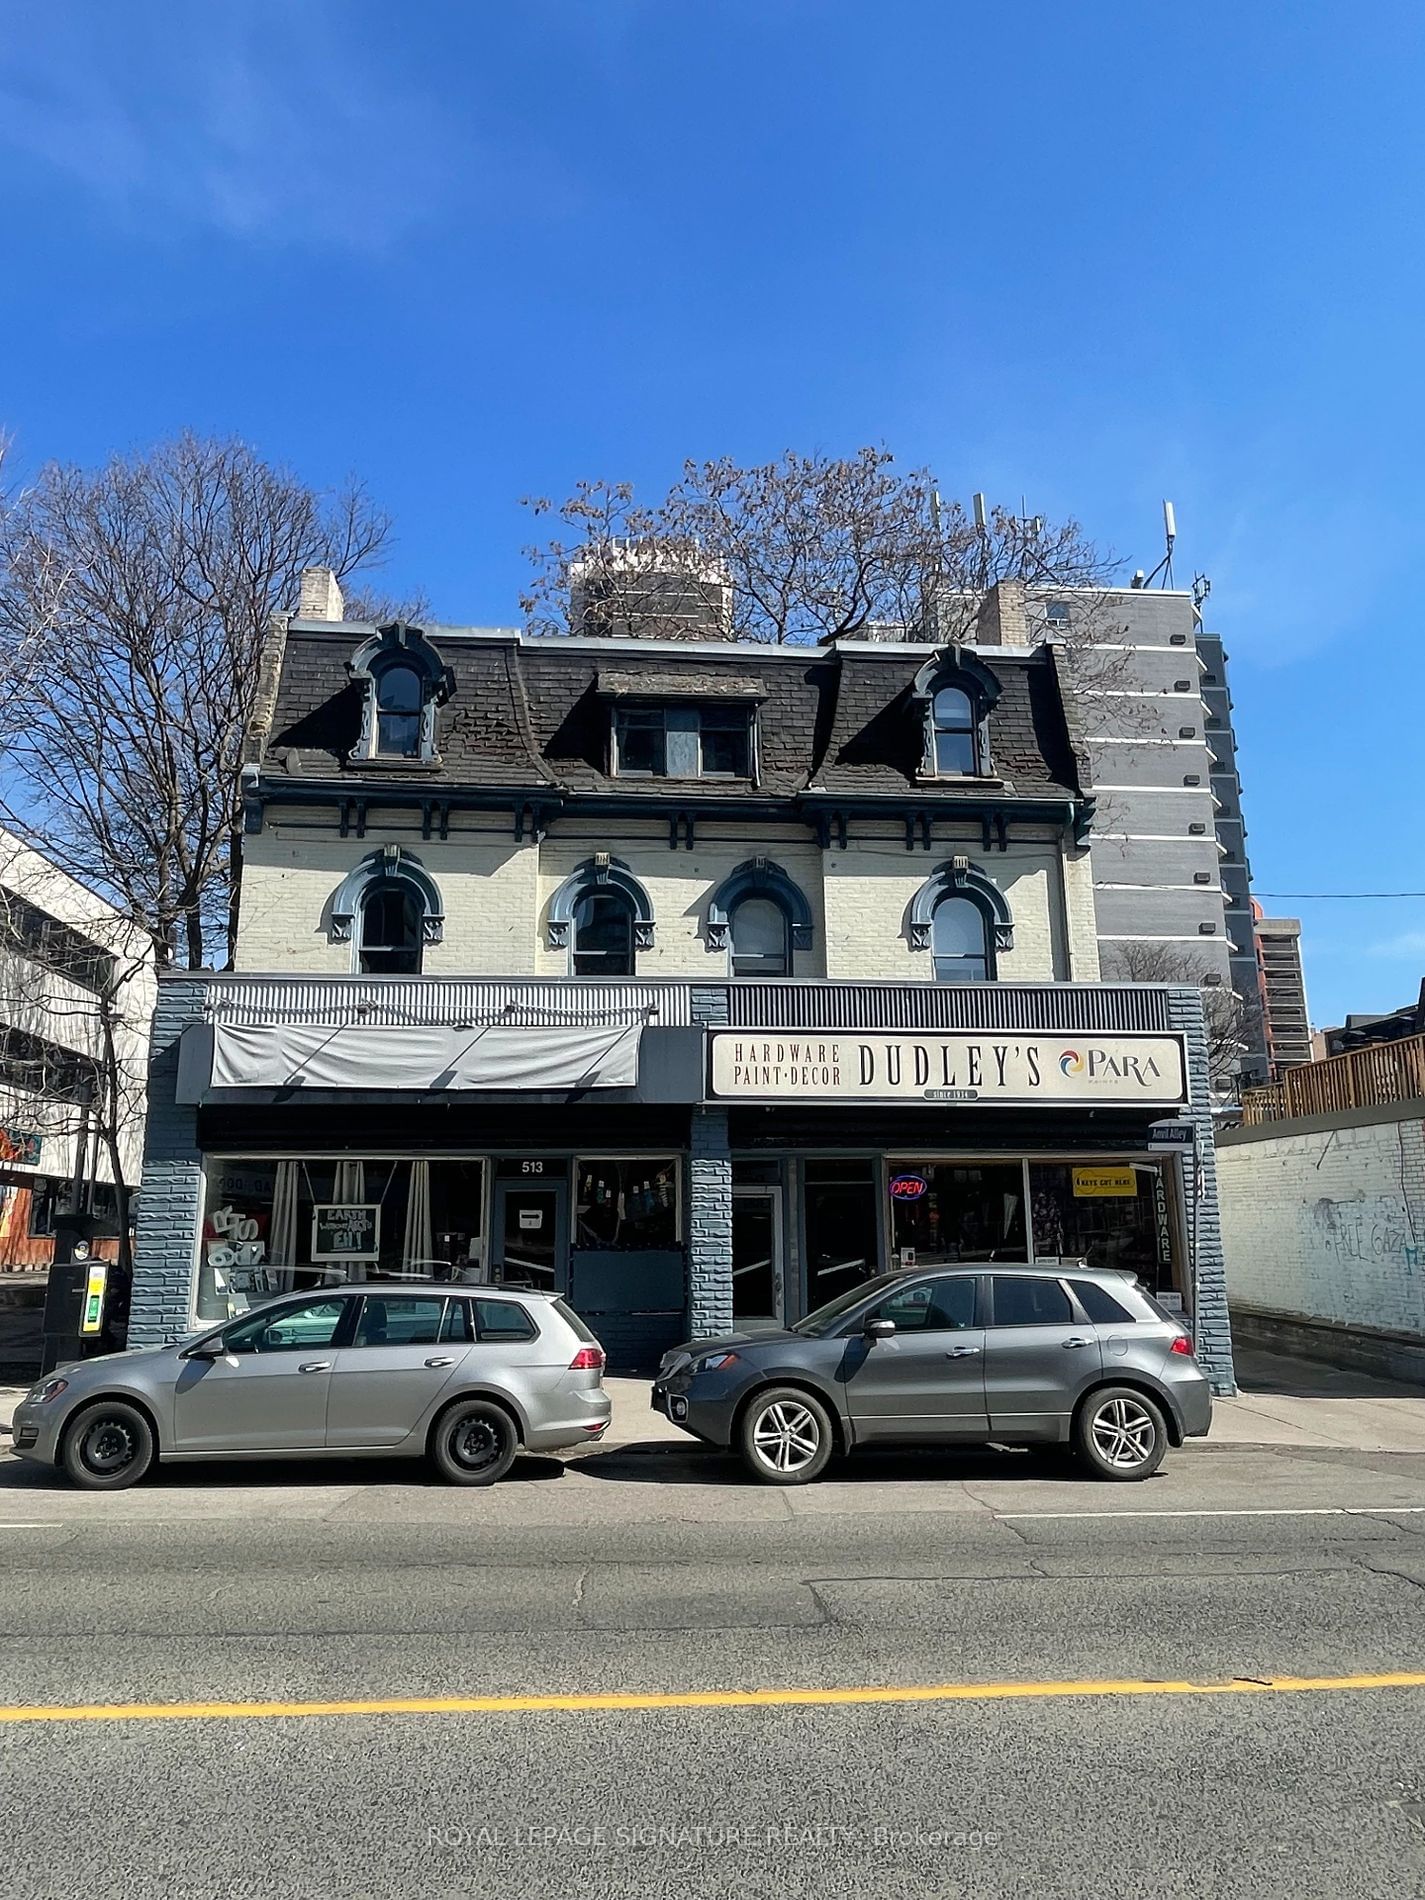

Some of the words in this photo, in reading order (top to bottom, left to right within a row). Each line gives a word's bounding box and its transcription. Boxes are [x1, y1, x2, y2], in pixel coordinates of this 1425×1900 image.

[735, 1043, 840, 1063] HARDWARE
[858, 1044, 1041, 1087] DUDLEY'S
[1088, 1049, 1161, 1087] PARA
[1170, 1128, 1187, 1141] Alley
[521, 1161, 543, 1173] 513
[891, 1181, 923, 1195] OPEN
[327, 1209, 367, 1220] EARTH
[1154, 1164, 1171, 1262] HARDWARE
